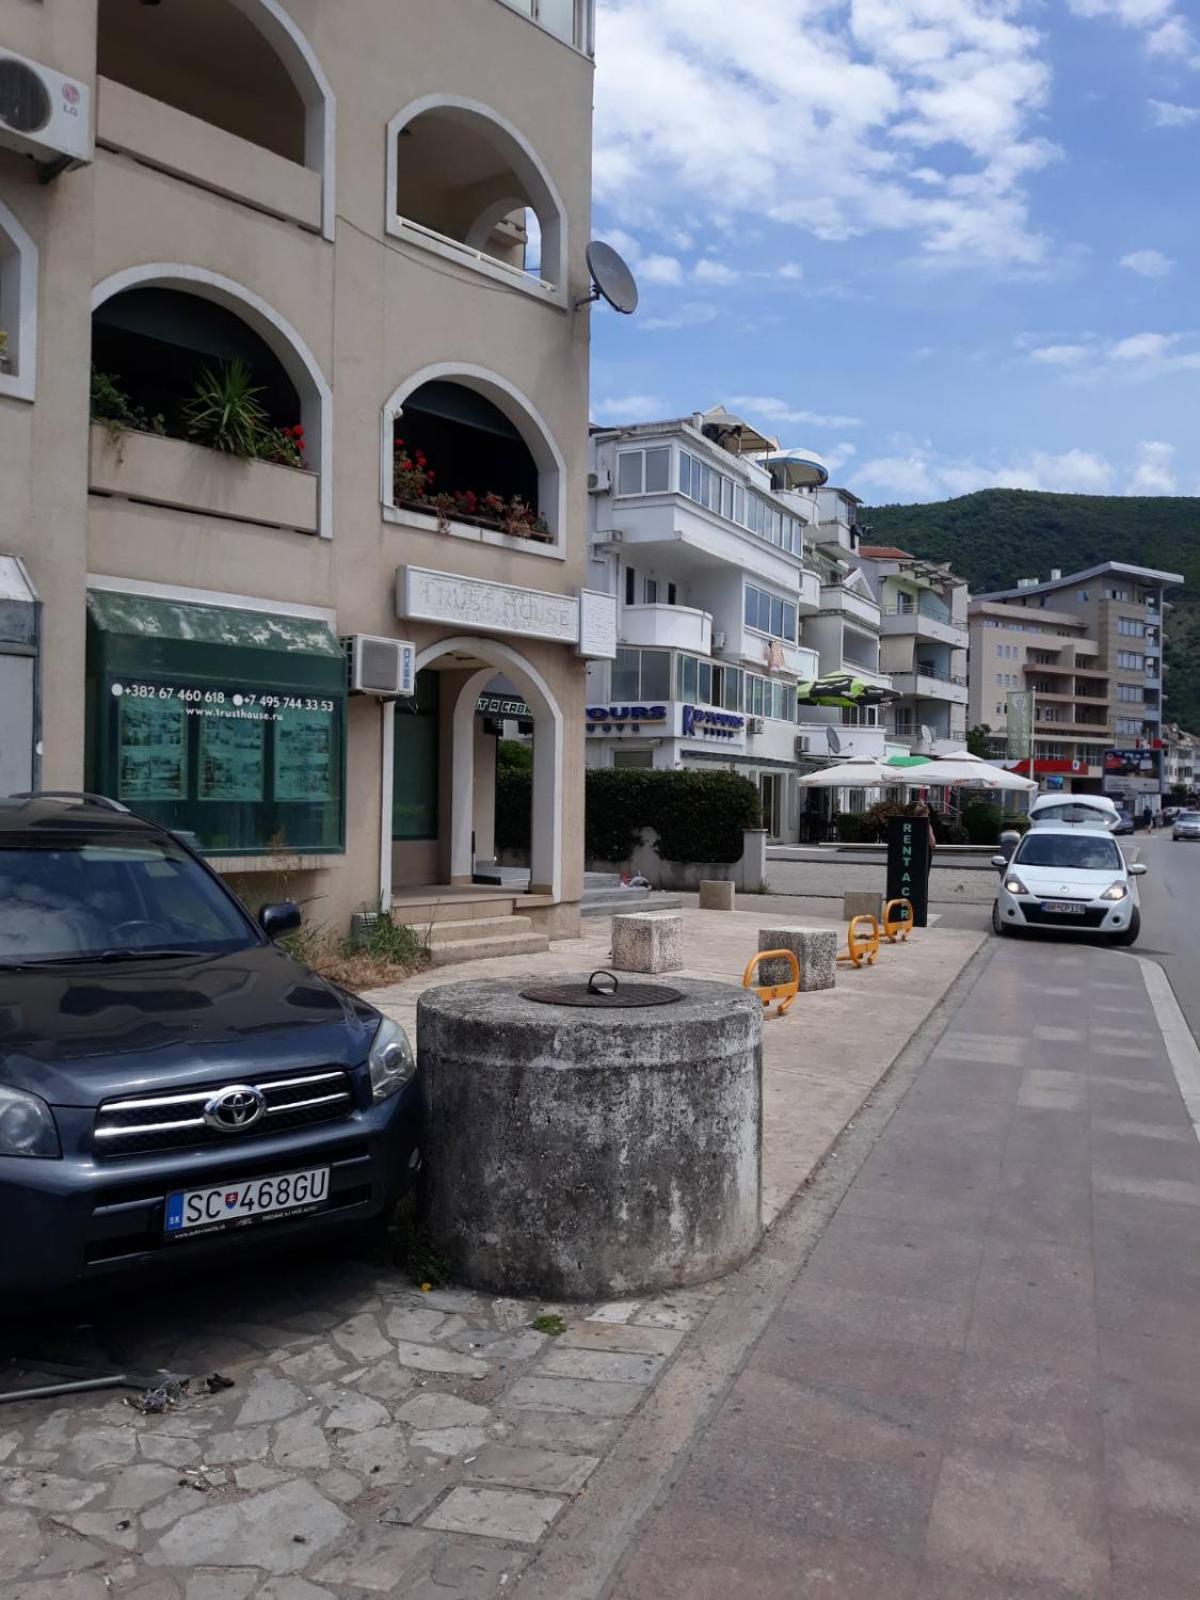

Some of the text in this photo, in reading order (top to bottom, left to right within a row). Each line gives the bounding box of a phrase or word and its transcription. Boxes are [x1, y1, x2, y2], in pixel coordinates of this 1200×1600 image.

[124, 684, 225, 704] +382 67 460 618
[244, 694, 334, 712] +7 495 744 33 53
[186, 707, 283, 720] www.trusthouse.ru
[586, 705, 667, 721] OURS
[901, 823, 912, 919] RENT A CR
[186, 1191, 222, 1222] SC
[239, 1171, 326, 1211] 468GU
[169, 1216, 181, 1226] SK
